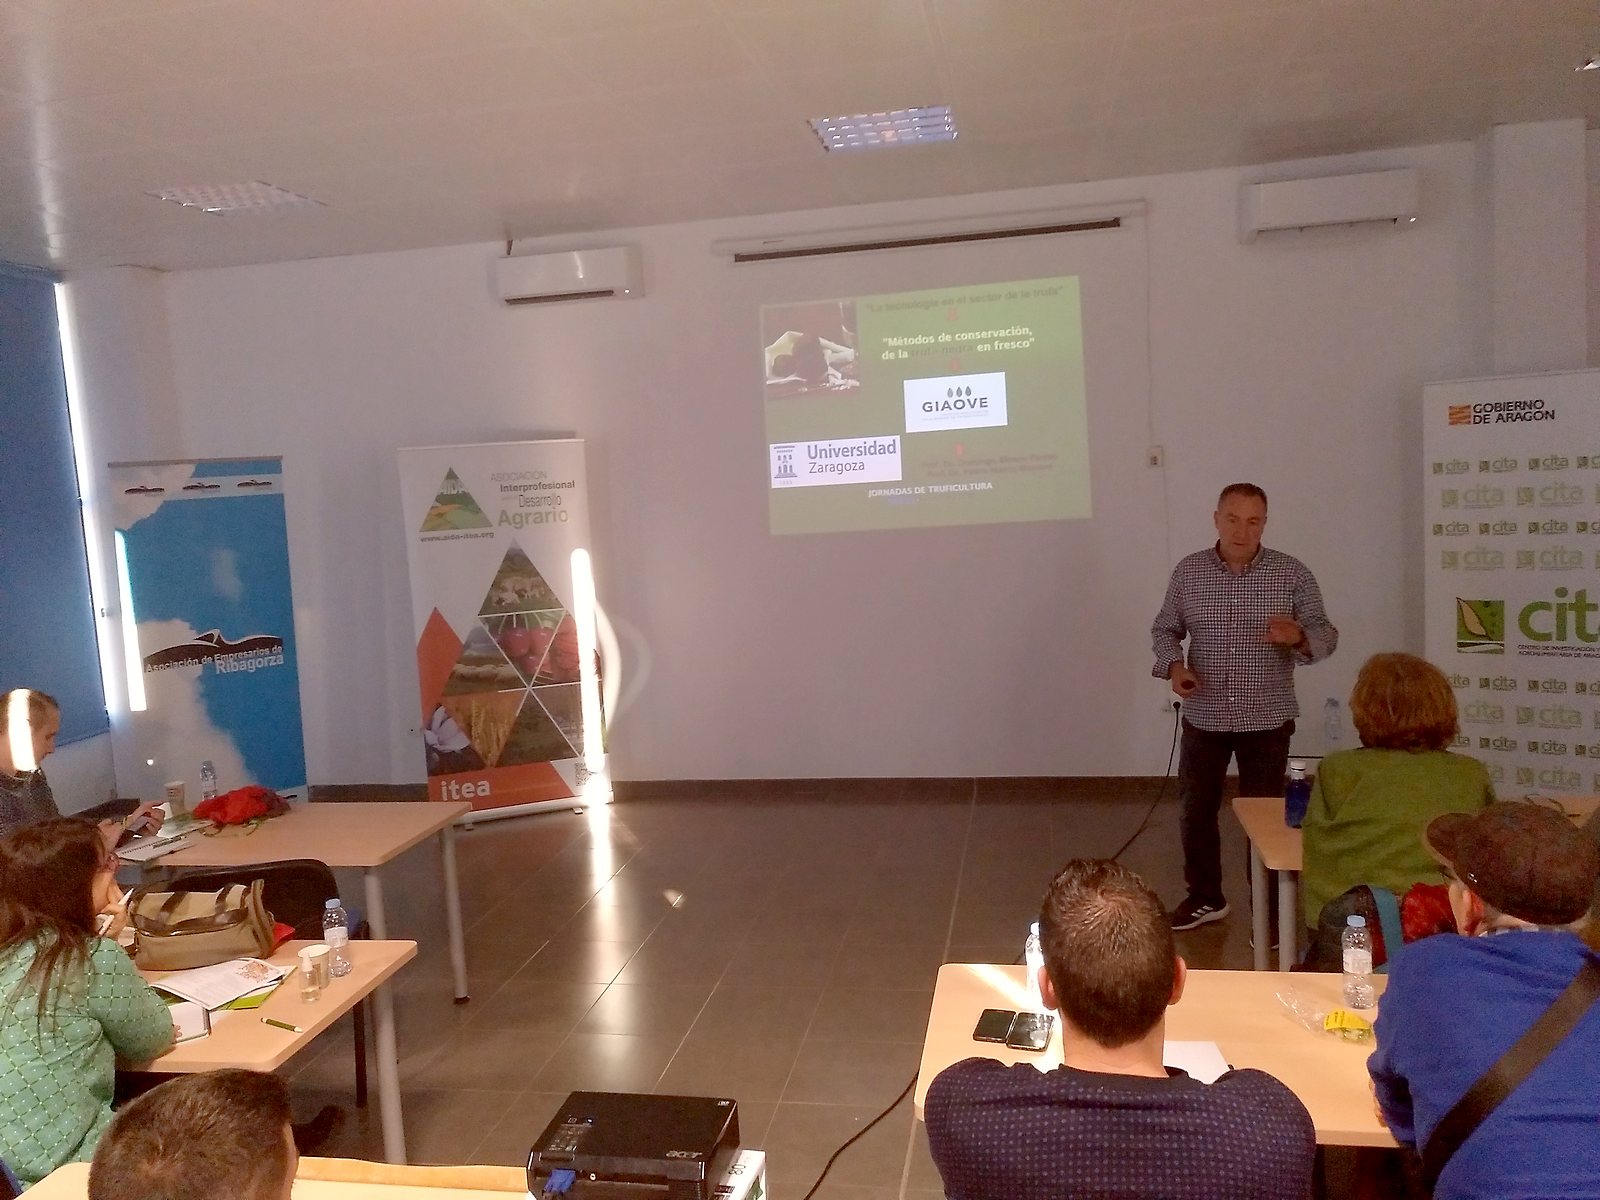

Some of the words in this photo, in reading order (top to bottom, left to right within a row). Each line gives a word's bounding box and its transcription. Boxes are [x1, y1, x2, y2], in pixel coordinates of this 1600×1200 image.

[883, 334, 935, 347] "Métodos
[938, 332, 951, 343] de
[955, 325, 1033, 341] conservación,
[882, 350, 896, 360] de
[898, 349, 908, 359] la
[977, 343, 990, 352] en
[994, 338, 1035, 350] fresco"
[922, 397, 988, 413] GIAOVE
[1473, 400, 1544, 413] GOBIERNO
[1473, 414, 1490, 424] DE
[807, 439, 897, 460] Universidad
[809, 461, 865, 475] Zaragoza
[1492, 456, 1517, 470] cita
[1542, 454, 1569, 468] cita
[500, 480, 575, 493] Interprofesional
[868, 485, 912, 498] JORNADAS
[914, 485, 925, 494] DE
[928, 482, 993, 493] TRUFICULTURA
[519, 493, 562, 508] Desarrollo
[498, 508, 569, 529] Agrario
[1445, 521, 1469, 534] cita
[1492, 520, 1517, 533] cita
[1542, 519, 1568, 532] cita
[1518, 587, 1600, 643] cit
[146, 656, 199, 672] Asociación
[202, 655, 213, 664] de
[214, 648, 269, 661] Empresarios
[272, 645, 282, 654] de
[215, 654, 284, 674] Ribagorza
[1493, 675, 1517, 689] cita
[1541, 678, 1567, 690] cita
[441, 780, 491, 800] itea
